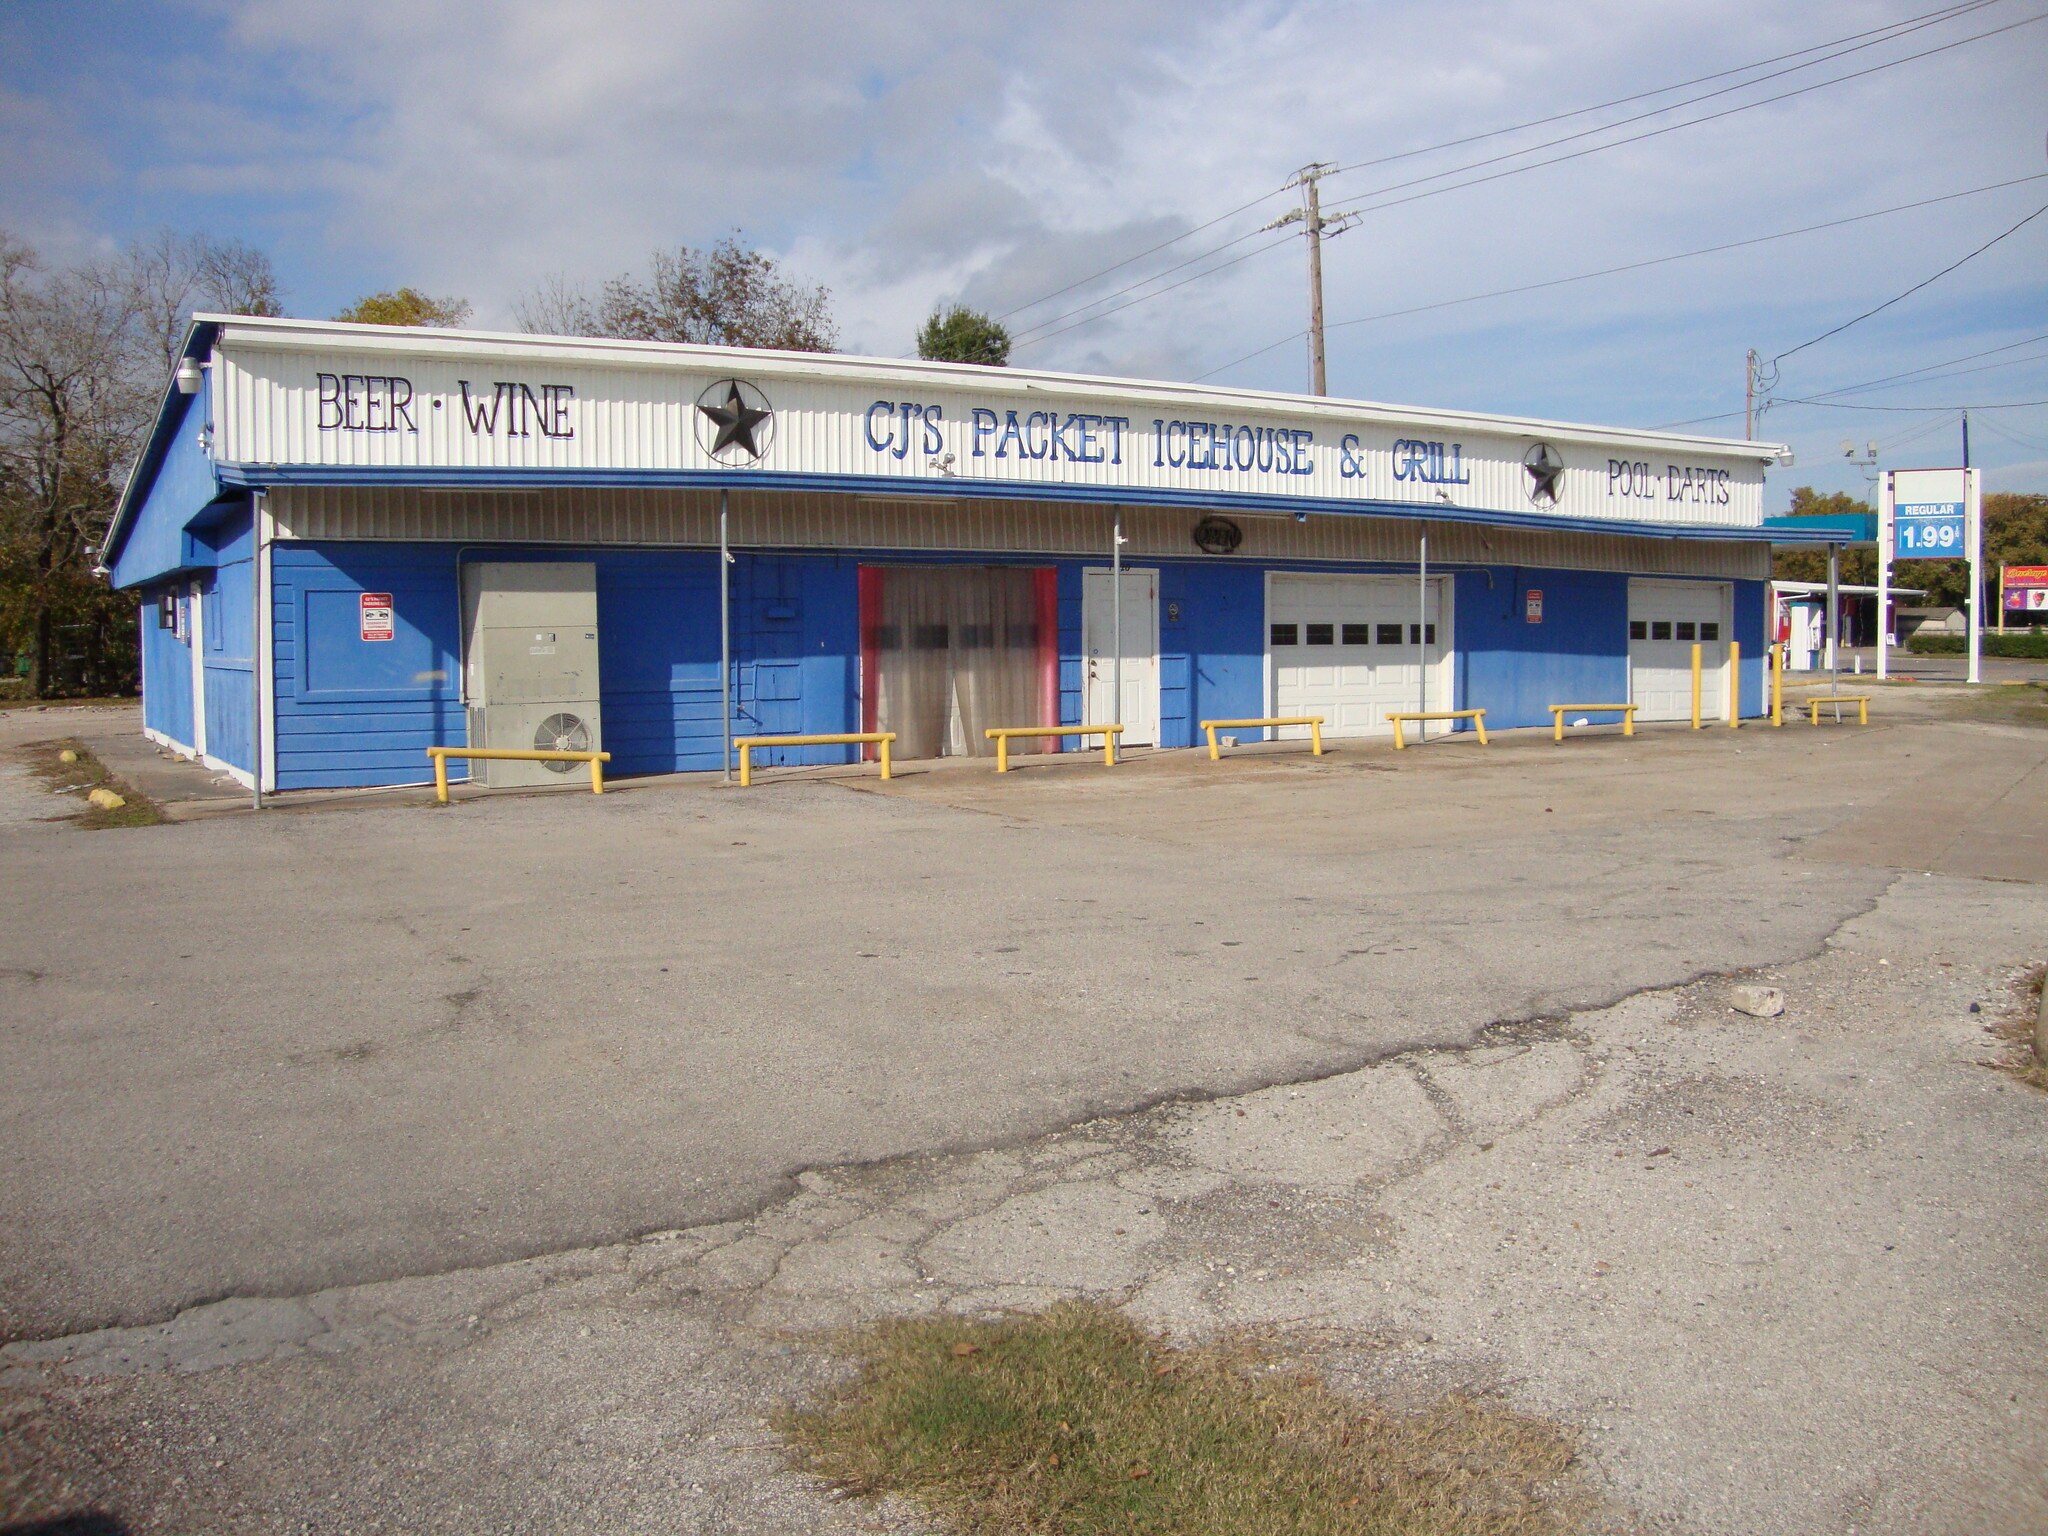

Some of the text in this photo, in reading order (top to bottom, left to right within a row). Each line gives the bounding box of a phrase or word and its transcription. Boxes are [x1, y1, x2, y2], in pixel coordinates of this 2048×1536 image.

[316, 373, 575, 439] BEER WINE
[865, 401, 1471, 484] CJ'S PACKET ICEHOUSE & GRILL
[1608, 459, 1730, 505] POOL DARTS
[1905, 504, 1955, 516] REGULAR
